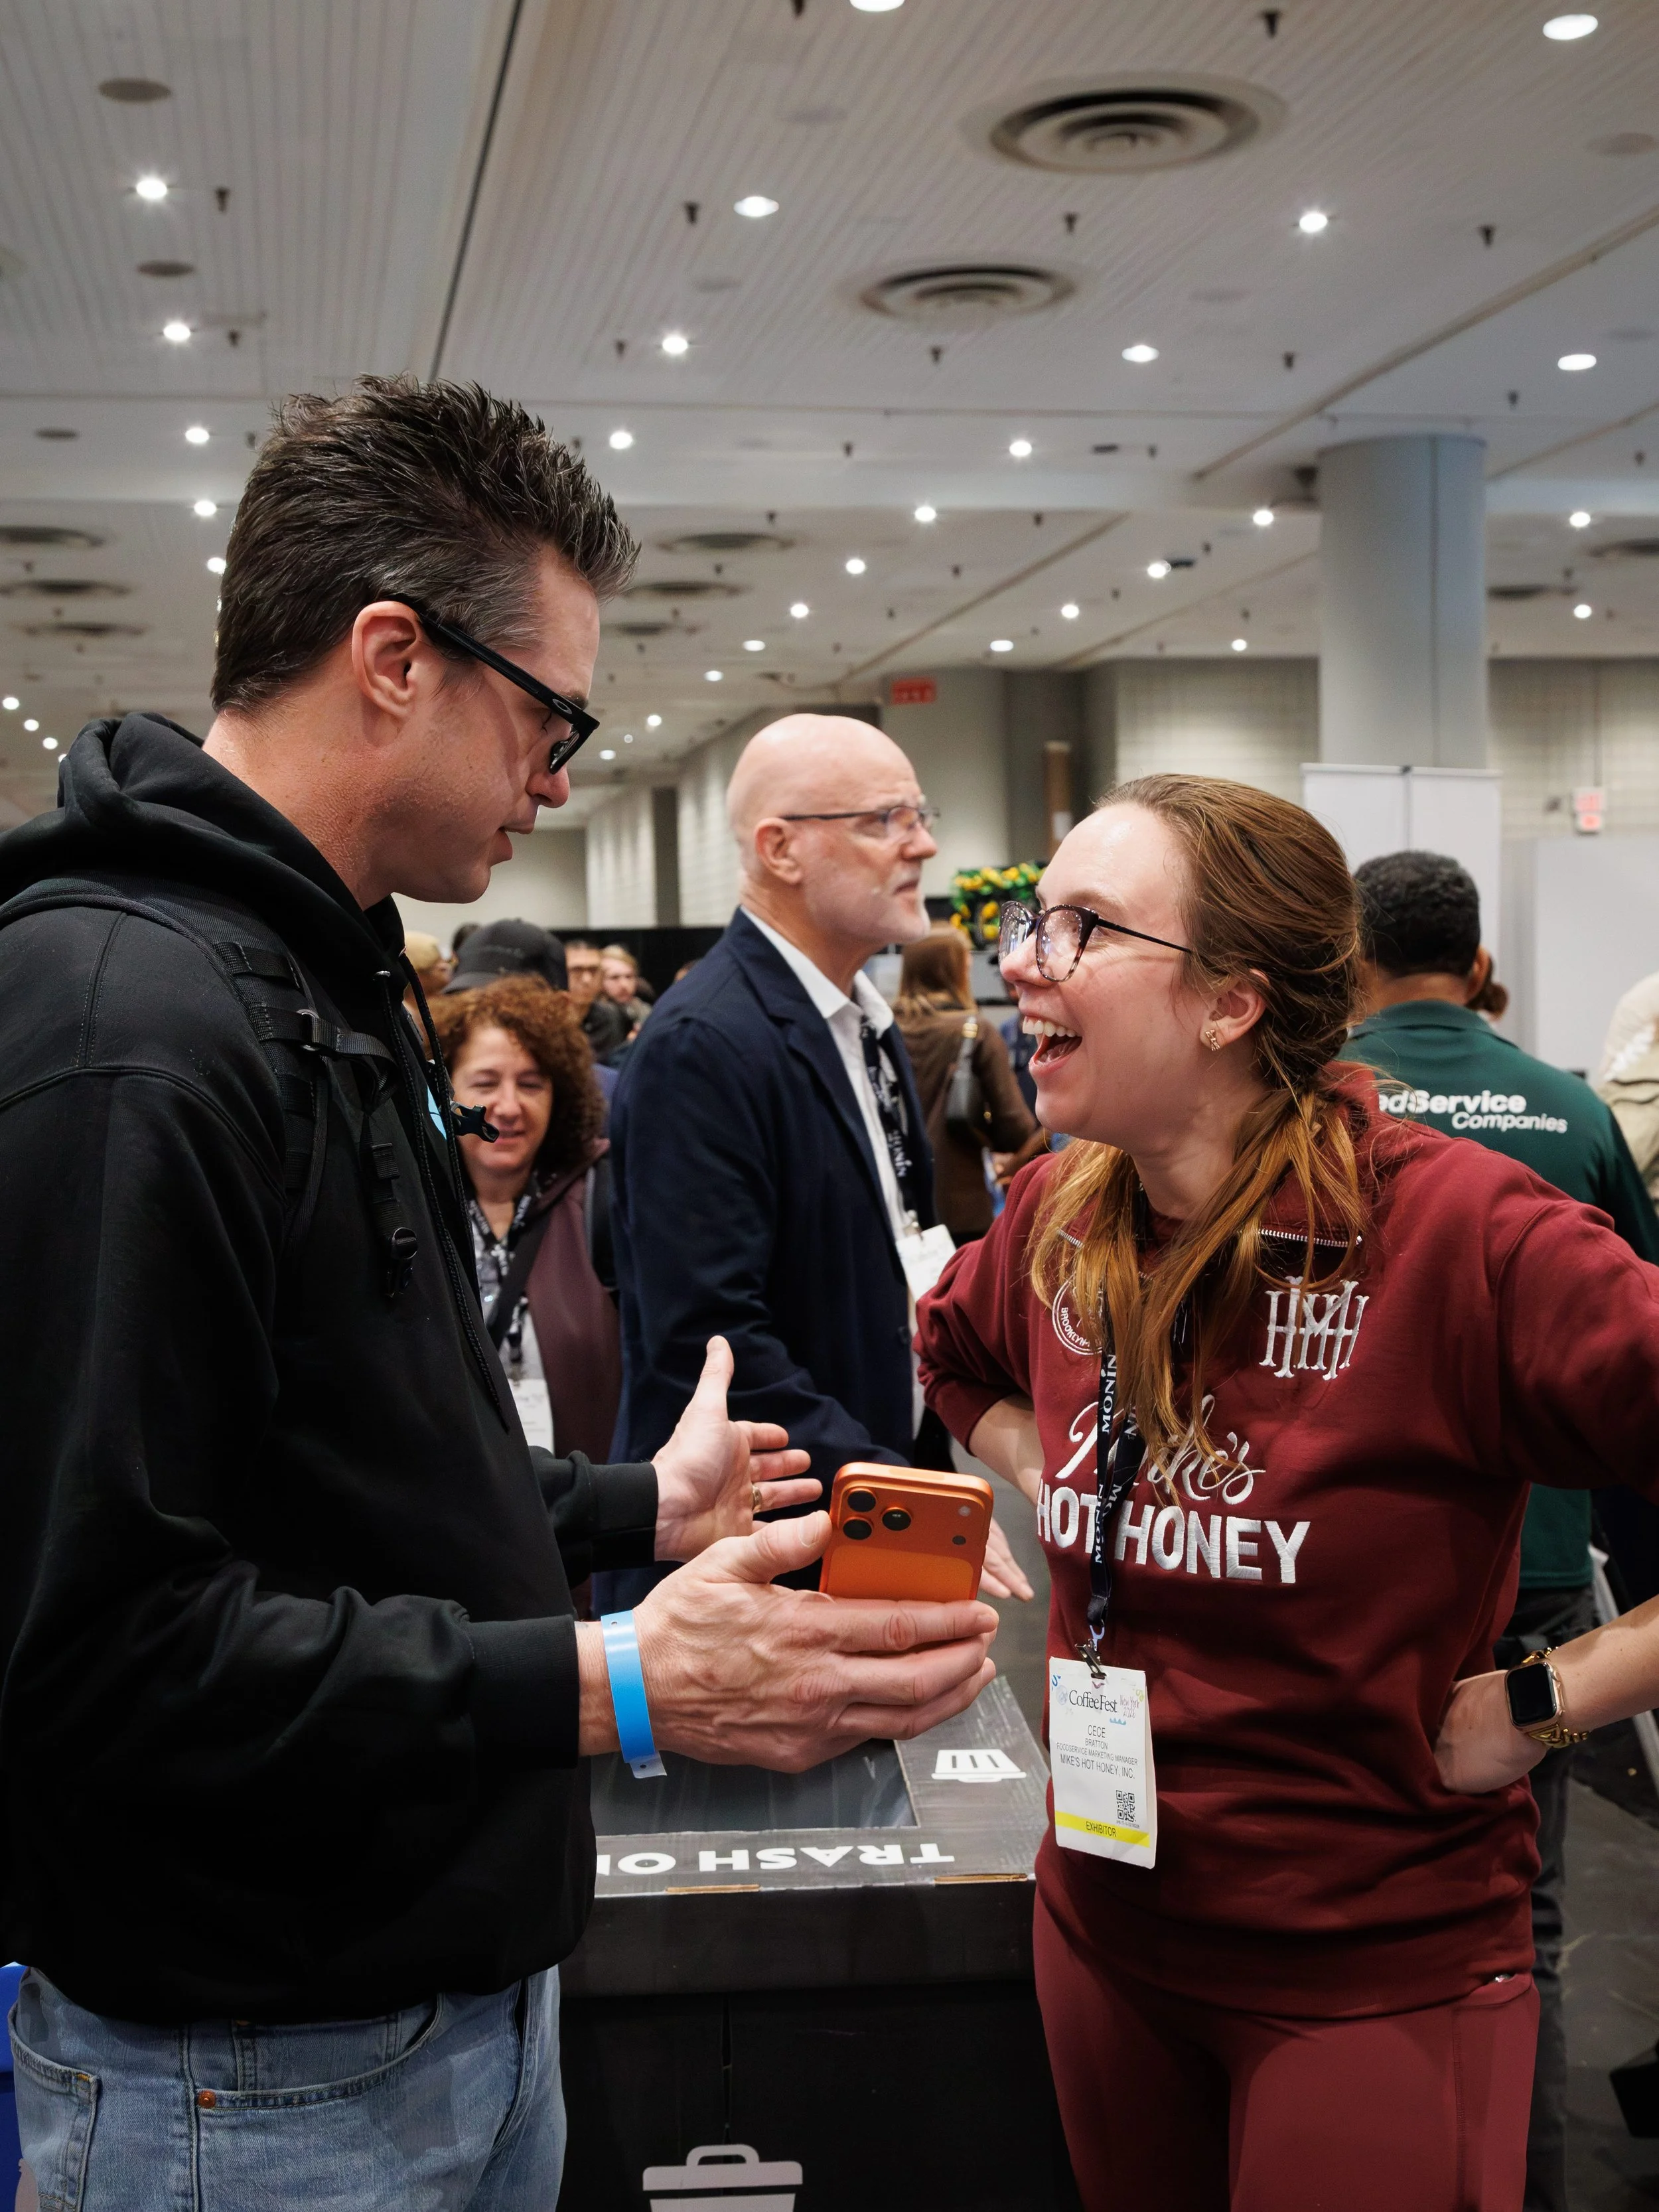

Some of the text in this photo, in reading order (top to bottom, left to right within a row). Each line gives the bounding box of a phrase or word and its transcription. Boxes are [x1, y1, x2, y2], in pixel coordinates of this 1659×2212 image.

[1451, 1112, 1568, 1134] Companies
[1037, 1478, 1098, 1554] HOT
[1114, 1499, 1311, 1584] HONEY
[1088, 1724, 1106, 1738] CECE
[1056, 1742, 1138, 1766] FOODSERVICE MARKETING MANAGER
[1085, 1738, 1108, 1750] BRATTON
[1060, 1753, 1135, 1779] MIKE'S HOT HONEY, INC.
[1086, 1820, 1117, 1838] EXHIBITOR
[698, 1843, 955, 1872] TRASH
